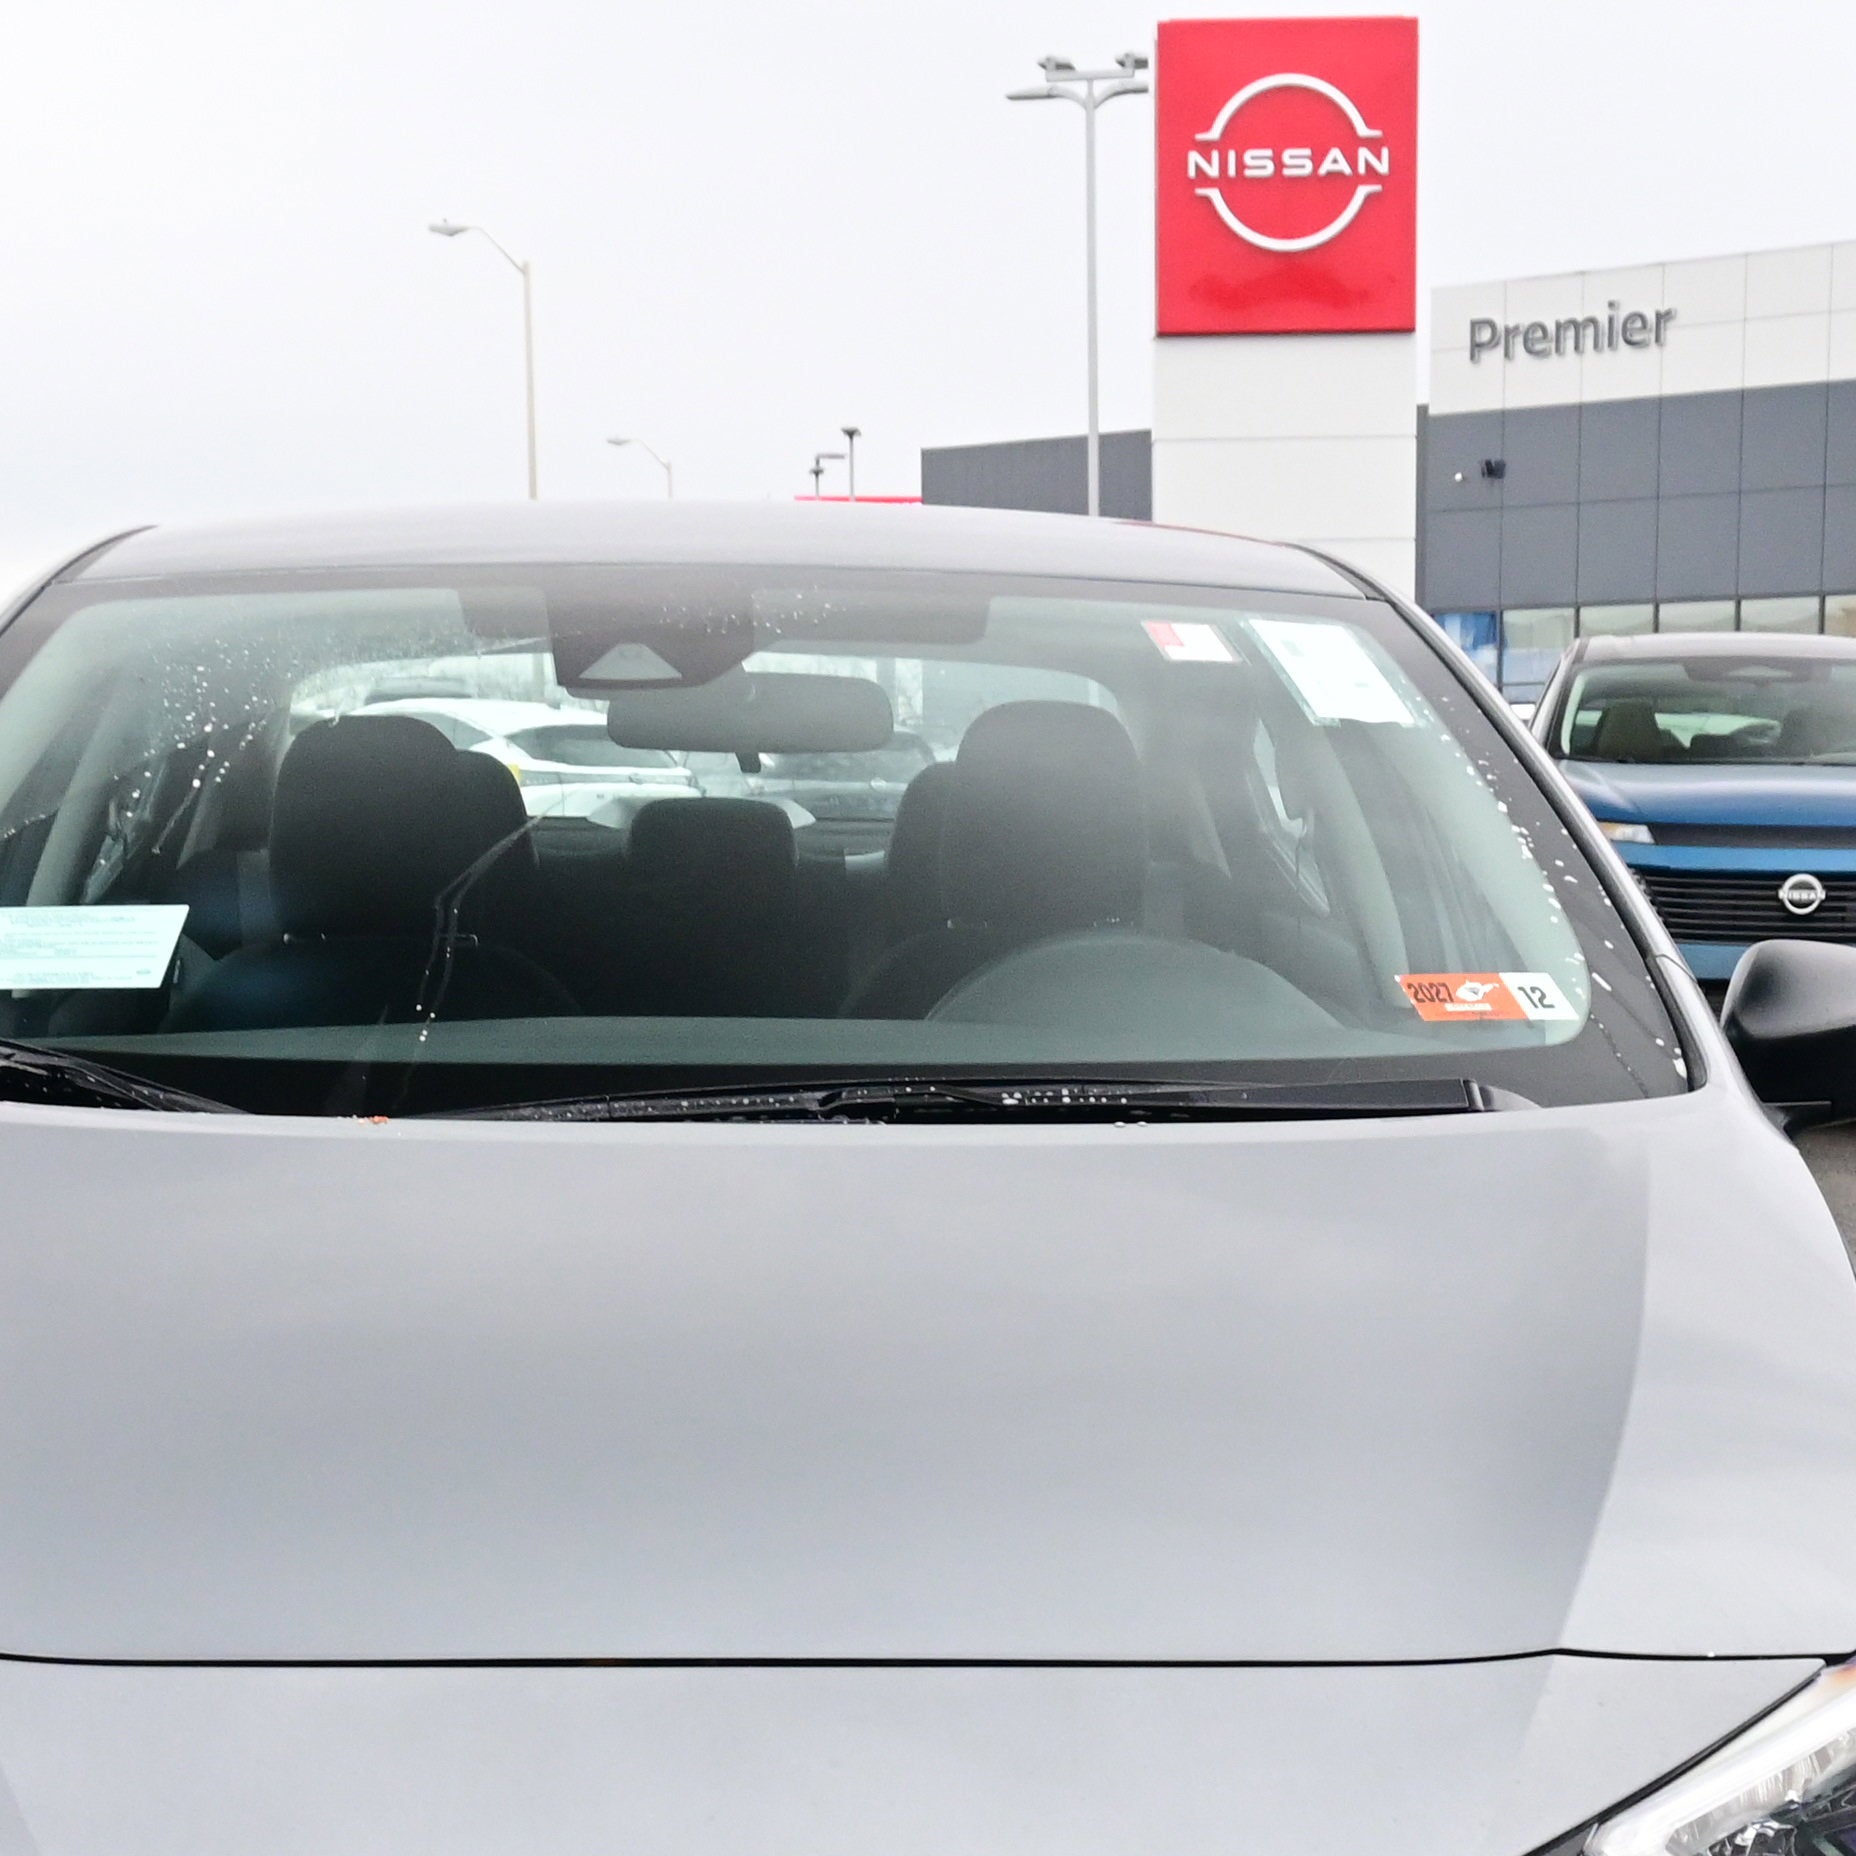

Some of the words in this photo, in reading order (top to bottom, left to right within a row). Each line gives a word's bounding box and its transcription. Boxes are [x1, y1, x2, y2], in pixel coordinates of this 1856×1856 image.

[1187, 146, 1390, 179] NISSAN
[1469, 300, 1675, 362] Premier
[1407, 982, 1454, 1003] 2027
[1518, 986, 1555, 1009] 12
